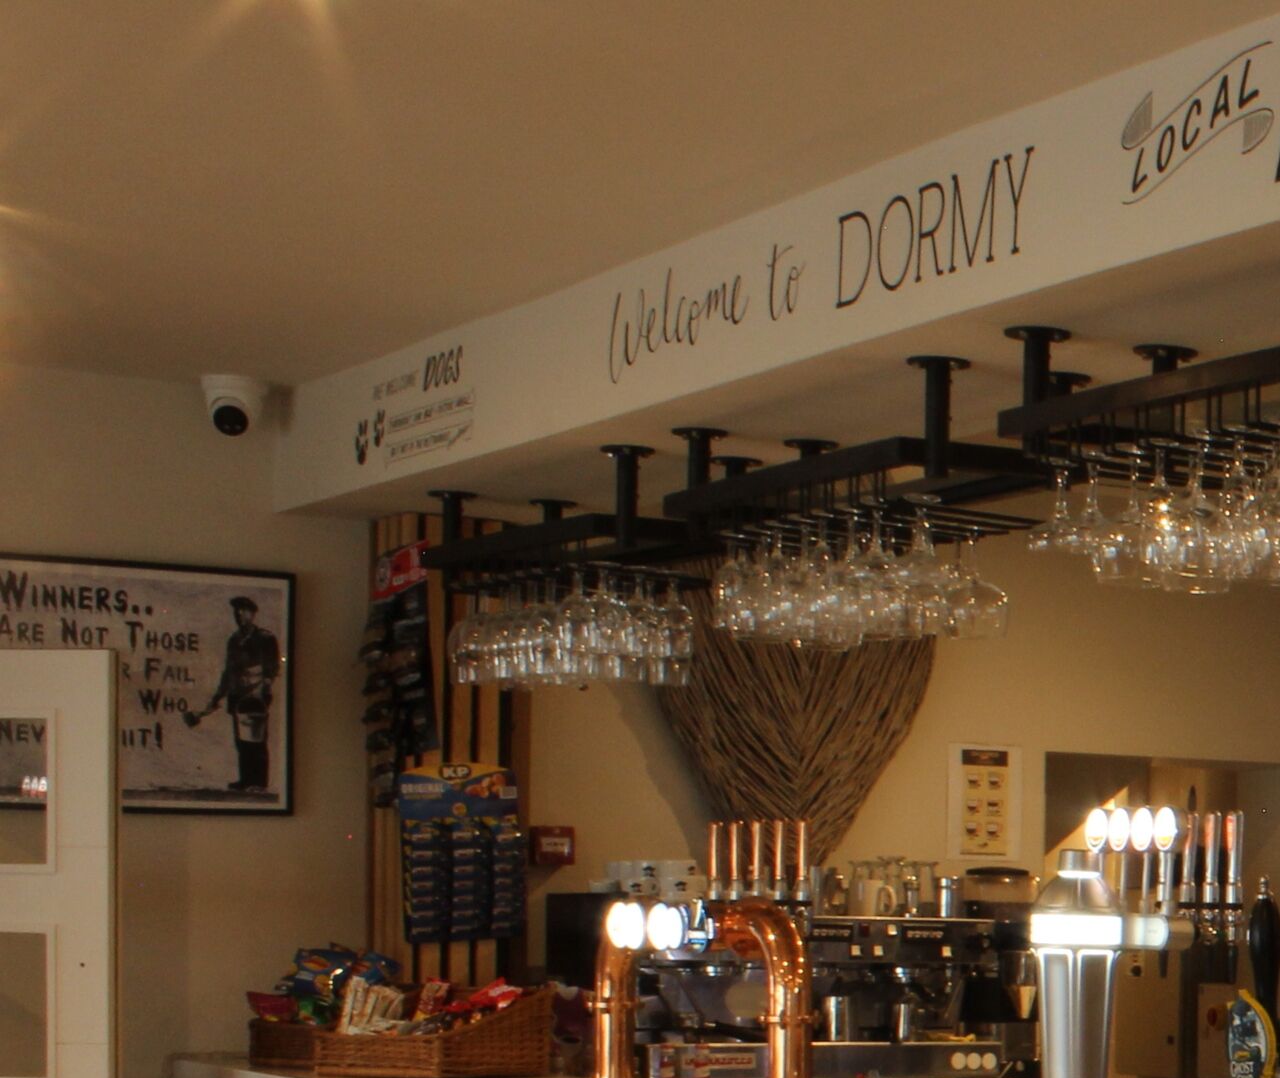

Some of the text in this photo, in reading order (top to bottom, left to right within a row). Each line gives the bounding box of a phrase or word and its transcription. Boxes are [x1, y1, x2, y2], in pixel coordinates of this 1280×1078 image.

[1131, 59, 1260, 193] LOCAL
[609, 146, 1035, 384] Welcome to DORMY
[422, 344, 463, 392] DOGS
[0, 614, 199, 652] ARE NOT THOSE
[144, 657, 195, 684] FAIL
[138, 689, 189, 715] WHO
[0, 722, 46, 743] NEV
[441, 765, 470, 780] KP
[1230, 1060, 1254, 1078] GHOST
